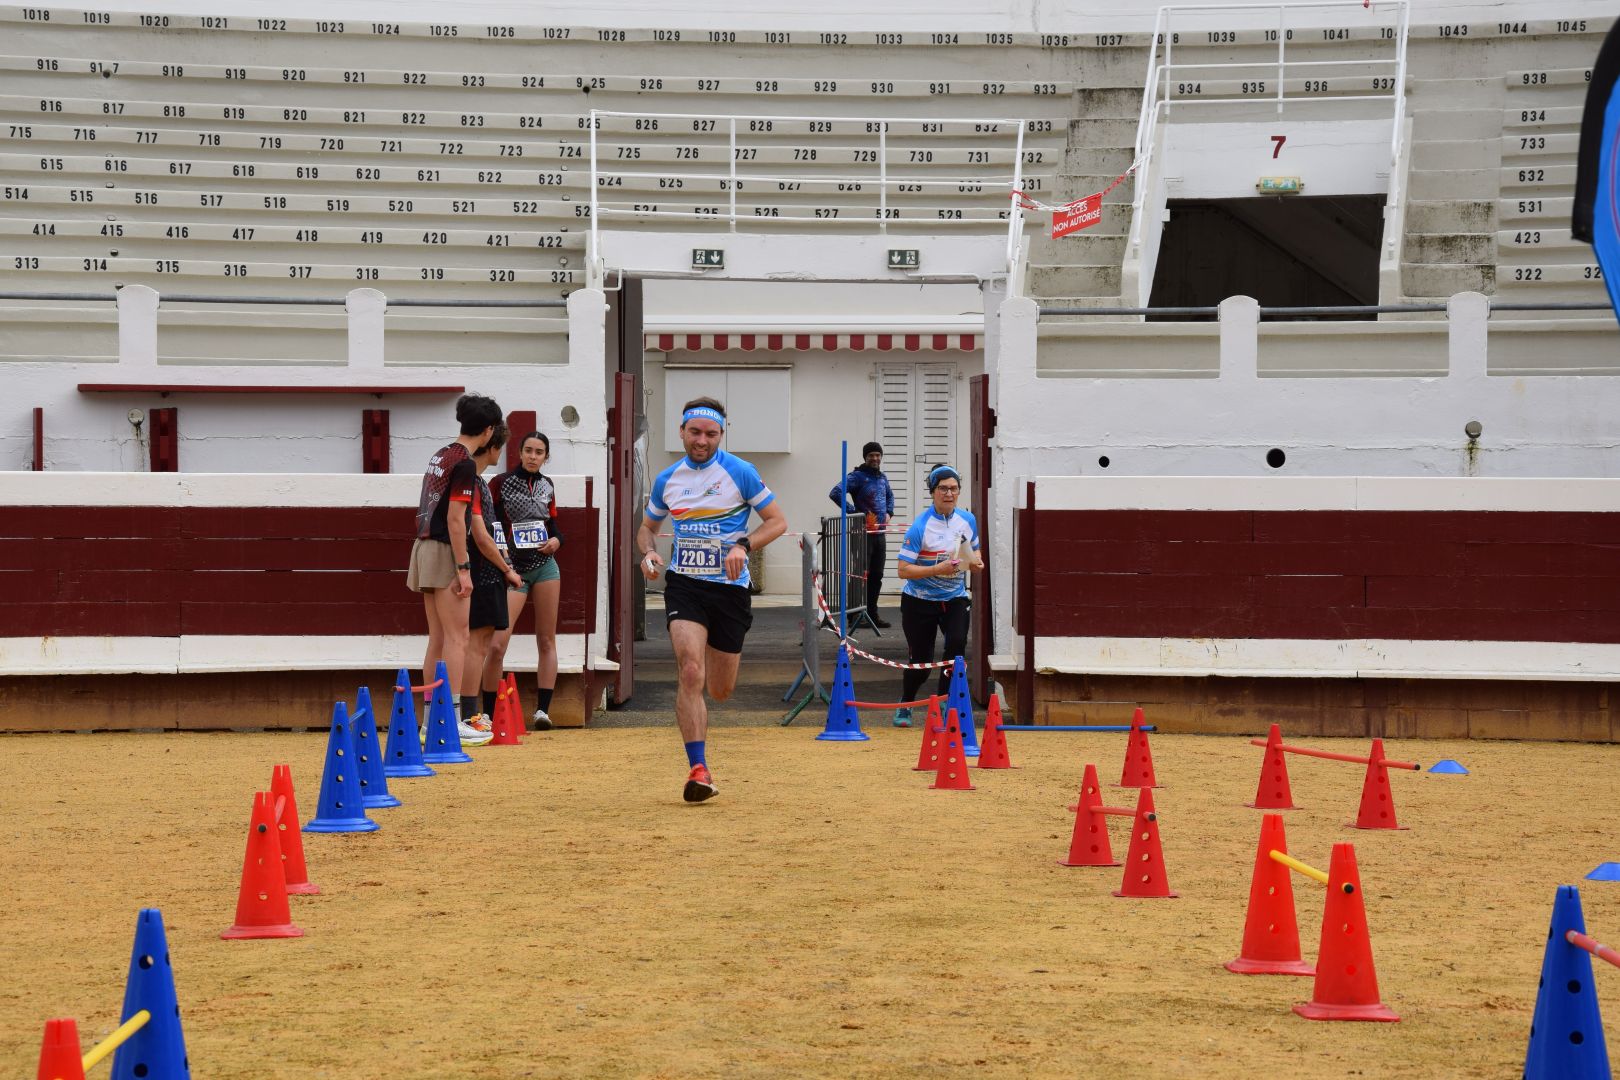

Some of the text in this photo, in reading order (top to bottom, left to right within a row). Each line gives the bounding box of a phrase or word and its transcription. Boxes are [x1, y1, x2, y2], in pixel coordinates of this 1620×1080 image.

[24, 9, 1122, 46] 1018 1019 1020 1021 1022 1023 1024 1025 1026 1027 1028 1029 1030 1031 1032 1033 1034 1035 1036 1037
[1208, 32, 1235, 42] 1039
[1265, 30, 1292, 41] 100
[1324, 29, 1348, 40] 1041
[1440, 21, 1585, 36] 1043 1044 1045
[38, 59, 58, 70] 916
[163, 66, 182, 77] 918
[226, 69, 245, 79] 919
[283, 70, 305, 80] 920
[344, 72, 364, 82] 921
[404, 73, 425, 84] 922
[463, 76, 484, 86] 923
[523, 77, 543, 87] 924
[641, 79, 662, 89] 926
[699, 80, 719, 90] 927
[756, 81, 777, 91] 928
[815, 82, 836, 92] 929
[872, 83, 893, 93] 930
[930, 83, 949, 94] 931
[983, 84, 1004, 94] 932
[1034, 85, 1056, 95] 933
[1523, 73, 1546, 84] 938
[1179, 79, 1395, 94] 934 935 936 937
[41, 100, 61, 111] 816
[104, 103, 124, 114] 817
[164, 106, 184, 117] 818
[224, 108, 244, 119] 819
[284, 110, 306, 120] 820
[344, 112, 364, 122] 821
[403, 113, 425, 124] 822
[462, 116, 483, 126] 823
[520, 117, 542, 127] 824
[636, 120, 657, 130] 826
[694, 120, 715, 131] 827
[751, 121, 772, 131] 828
[810, 122, 831, 132] 829
[1029, 121, 1051, 132] 833
[1522, 111, 1545, 121] 834
[10, 126, 31, 138] 715
[74, 129, 95, 140] 716
[137, 132, 157, 143] 717
[200, 134, 220, 145] 718
[261, 138, 281, 148] 719
[321, 139, 343, 150] 720
[381, 141, 401, 152] 721
[441, 143, 462, 154] 722
[500, 145, 522, 156] 723
[560, 147, 581, 157] 724
[618, 148, 640, 158] 725
[677, 148, 698, 158] 726
[735, 149, 756, 159] 727
[795, 149, 816, 160] 728
[855, 151, 876, 161] 729
[911, 151, 932, 162] 730
[969, 152, 988, 162] 731
[1271, 136, 1286, 159] 7
[1521, 138, 1544, 149] 733
[41, 159, 62, 170] 615
[106, 160, 126, 171] 616
[170, 163, 191, 174] 617
[233, 165, 254, 176] 618
[297, 167, 318, 178] 619
[357, 168, 379, 179] 620
[418, 170, 439, 181] 621
[479, 172, 501, 182] 622
[539, 174, 561, 185] 623
[720, 180, 743, 190] 66
[1519, 170, 1543, 181] 632
[6, 188, 28, 199] 514
[71, 190, 92, 201] 515
[136, 193, 157, 204] 516
[201, 195, 222, 206] 517
[265, 197, 286, 208] 518
[328, 200, 349, 211] 519
[389, 201, 412, 212] 520
[453, 202, 474, 212] 521
[514, 202, 537, 213] 522
[576, 206, 591, 216] 52
[816, 209, 838, 219] 527
[1519, 201, 1541, 213] 531
[1053, 206, 1101, 233] NON AUTORISÉ
[33, 224, 562, 248] 414 415 416 417 418 419 420 421 422
[1515, 232, 1540, 243] 423
[16, 258, 572, 283] 313 314 315 316 317 318 319 320 321
[1516, 267, 1601, 280] 322 32
[681, 549, 716, 566] 220.3
